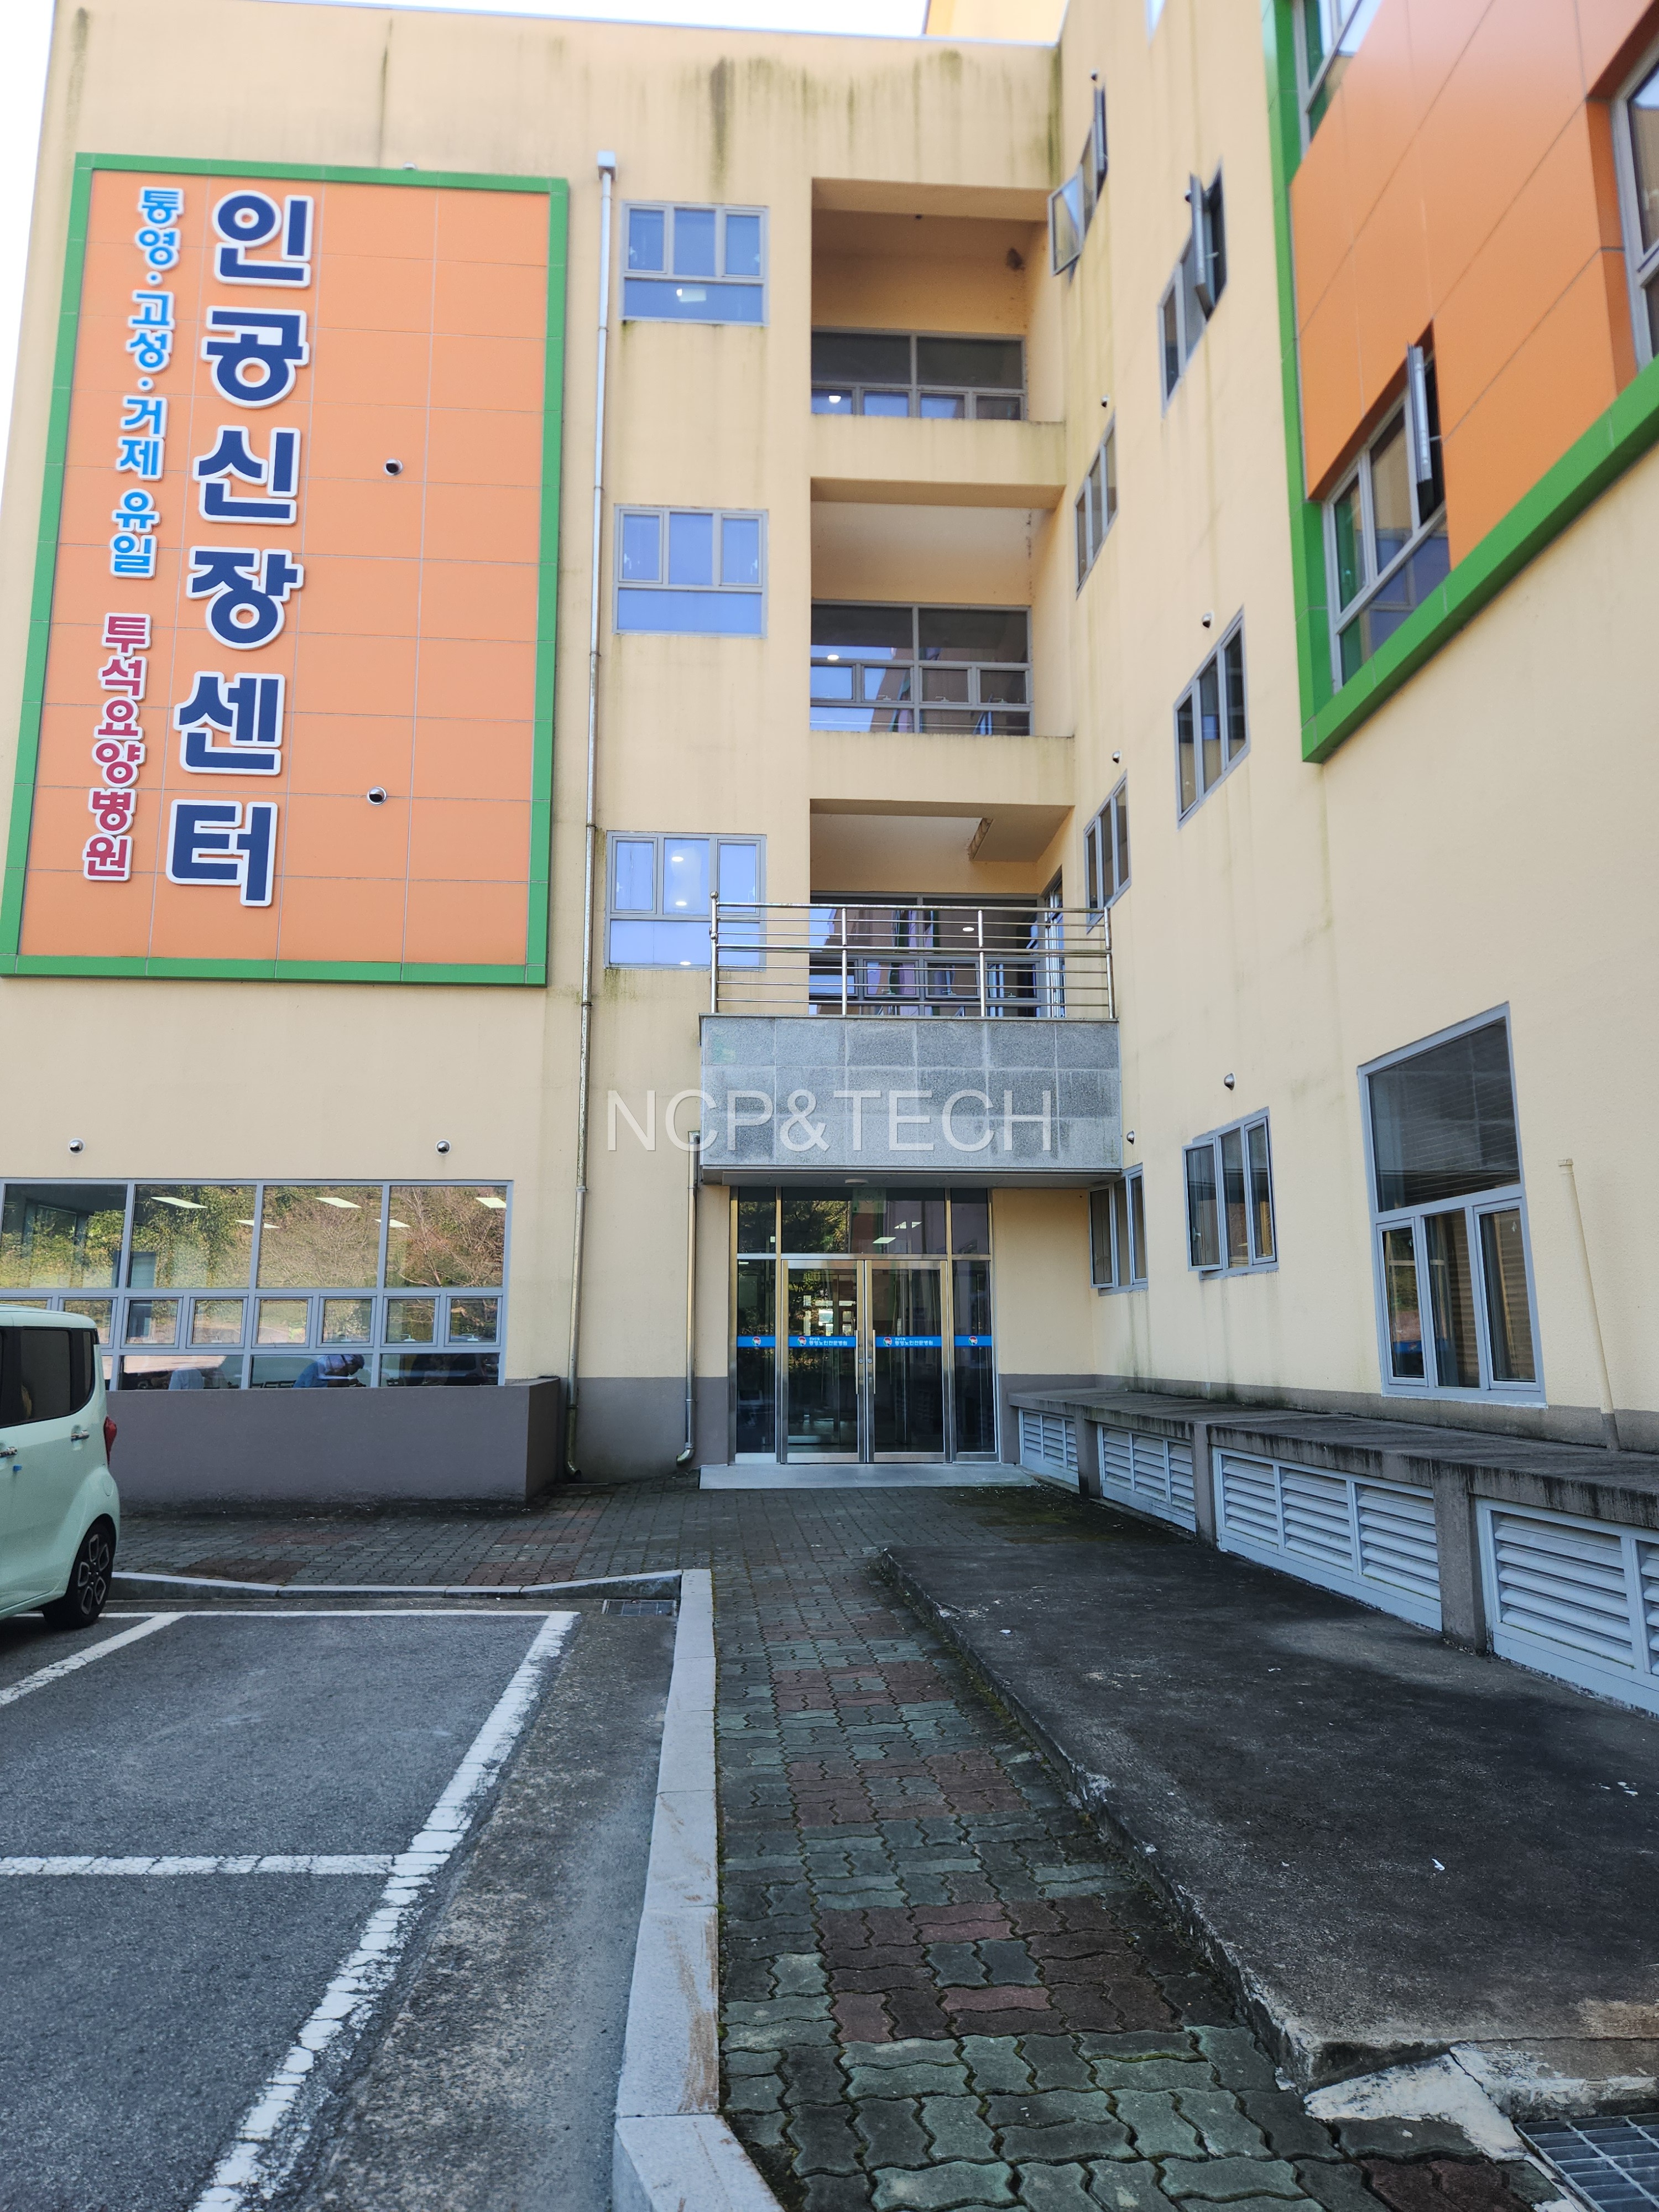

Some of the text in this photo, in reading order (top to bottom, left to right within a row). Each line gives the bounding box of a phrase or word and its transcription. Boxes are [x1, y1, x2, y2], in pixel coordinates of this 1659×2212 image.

[109, 488, 160, 578] 유일
[166, 190, 314, 906] 인공신장센터
[82, 612, 153, 881] 투석요양병원
